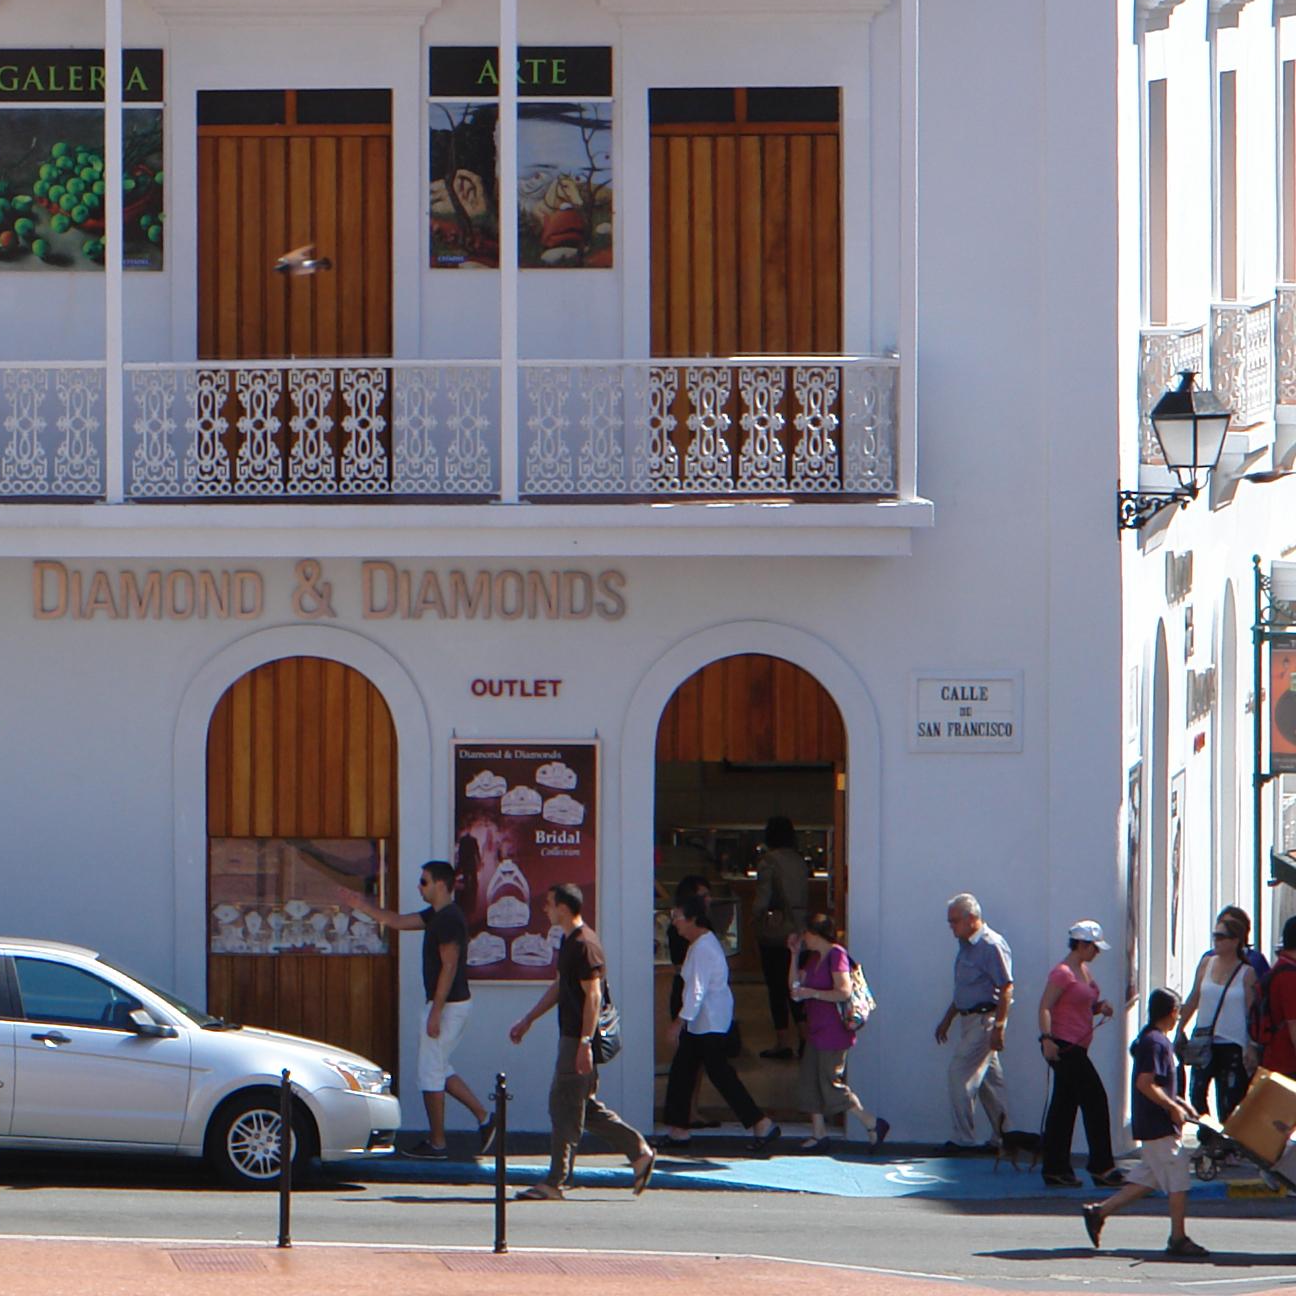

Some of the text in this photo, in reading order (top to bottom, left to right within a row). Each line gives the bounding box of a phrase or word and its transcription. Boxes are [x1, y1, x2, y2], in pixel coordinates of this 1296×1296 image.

[32, 557, 627, 622] DIAMOND & DIAMONDS
[470, 678, 562, 698] OUTLET
[940, 685, 989, 702] CALLE
[917, 721, 1014, 738] SAN FRANCISCO
[459, 749, 562, 760] Diamond & Diamonds
[535, 830, 581, 845] Bridal
